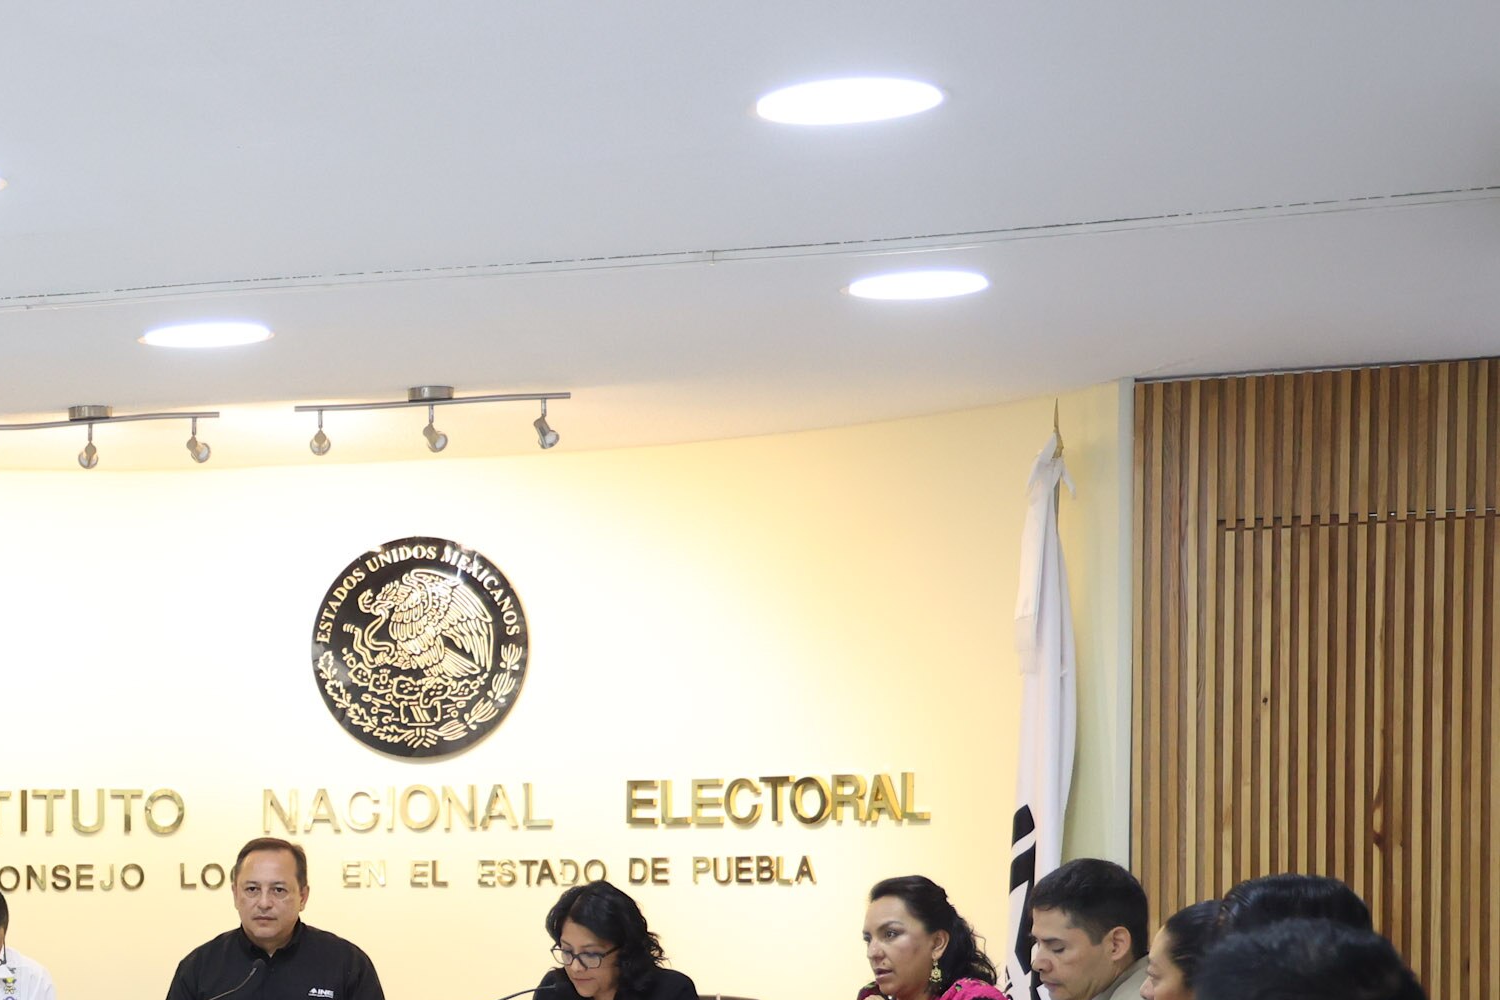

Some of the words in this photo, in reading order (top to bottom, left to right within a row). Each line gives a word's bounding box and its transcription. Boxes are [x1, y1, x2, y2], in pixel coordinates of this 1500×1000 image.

[316, 568, 366, 644] ESTADOS
[365, 545, 437, 573] UNIDOS
[441, 546, 520, 636] MEXICANOS
[263, 783, 554, 833] NACIONAL
[626, 772, 931, 825] ELECTORAL
[342, 860, 387, 888] EN
[410, 860, 449, 888] EL
[478, 859, 607, 887] ESTADO
[628, 857, 670, 885] DE
[692, 856, 817, 885] PUEBLA
